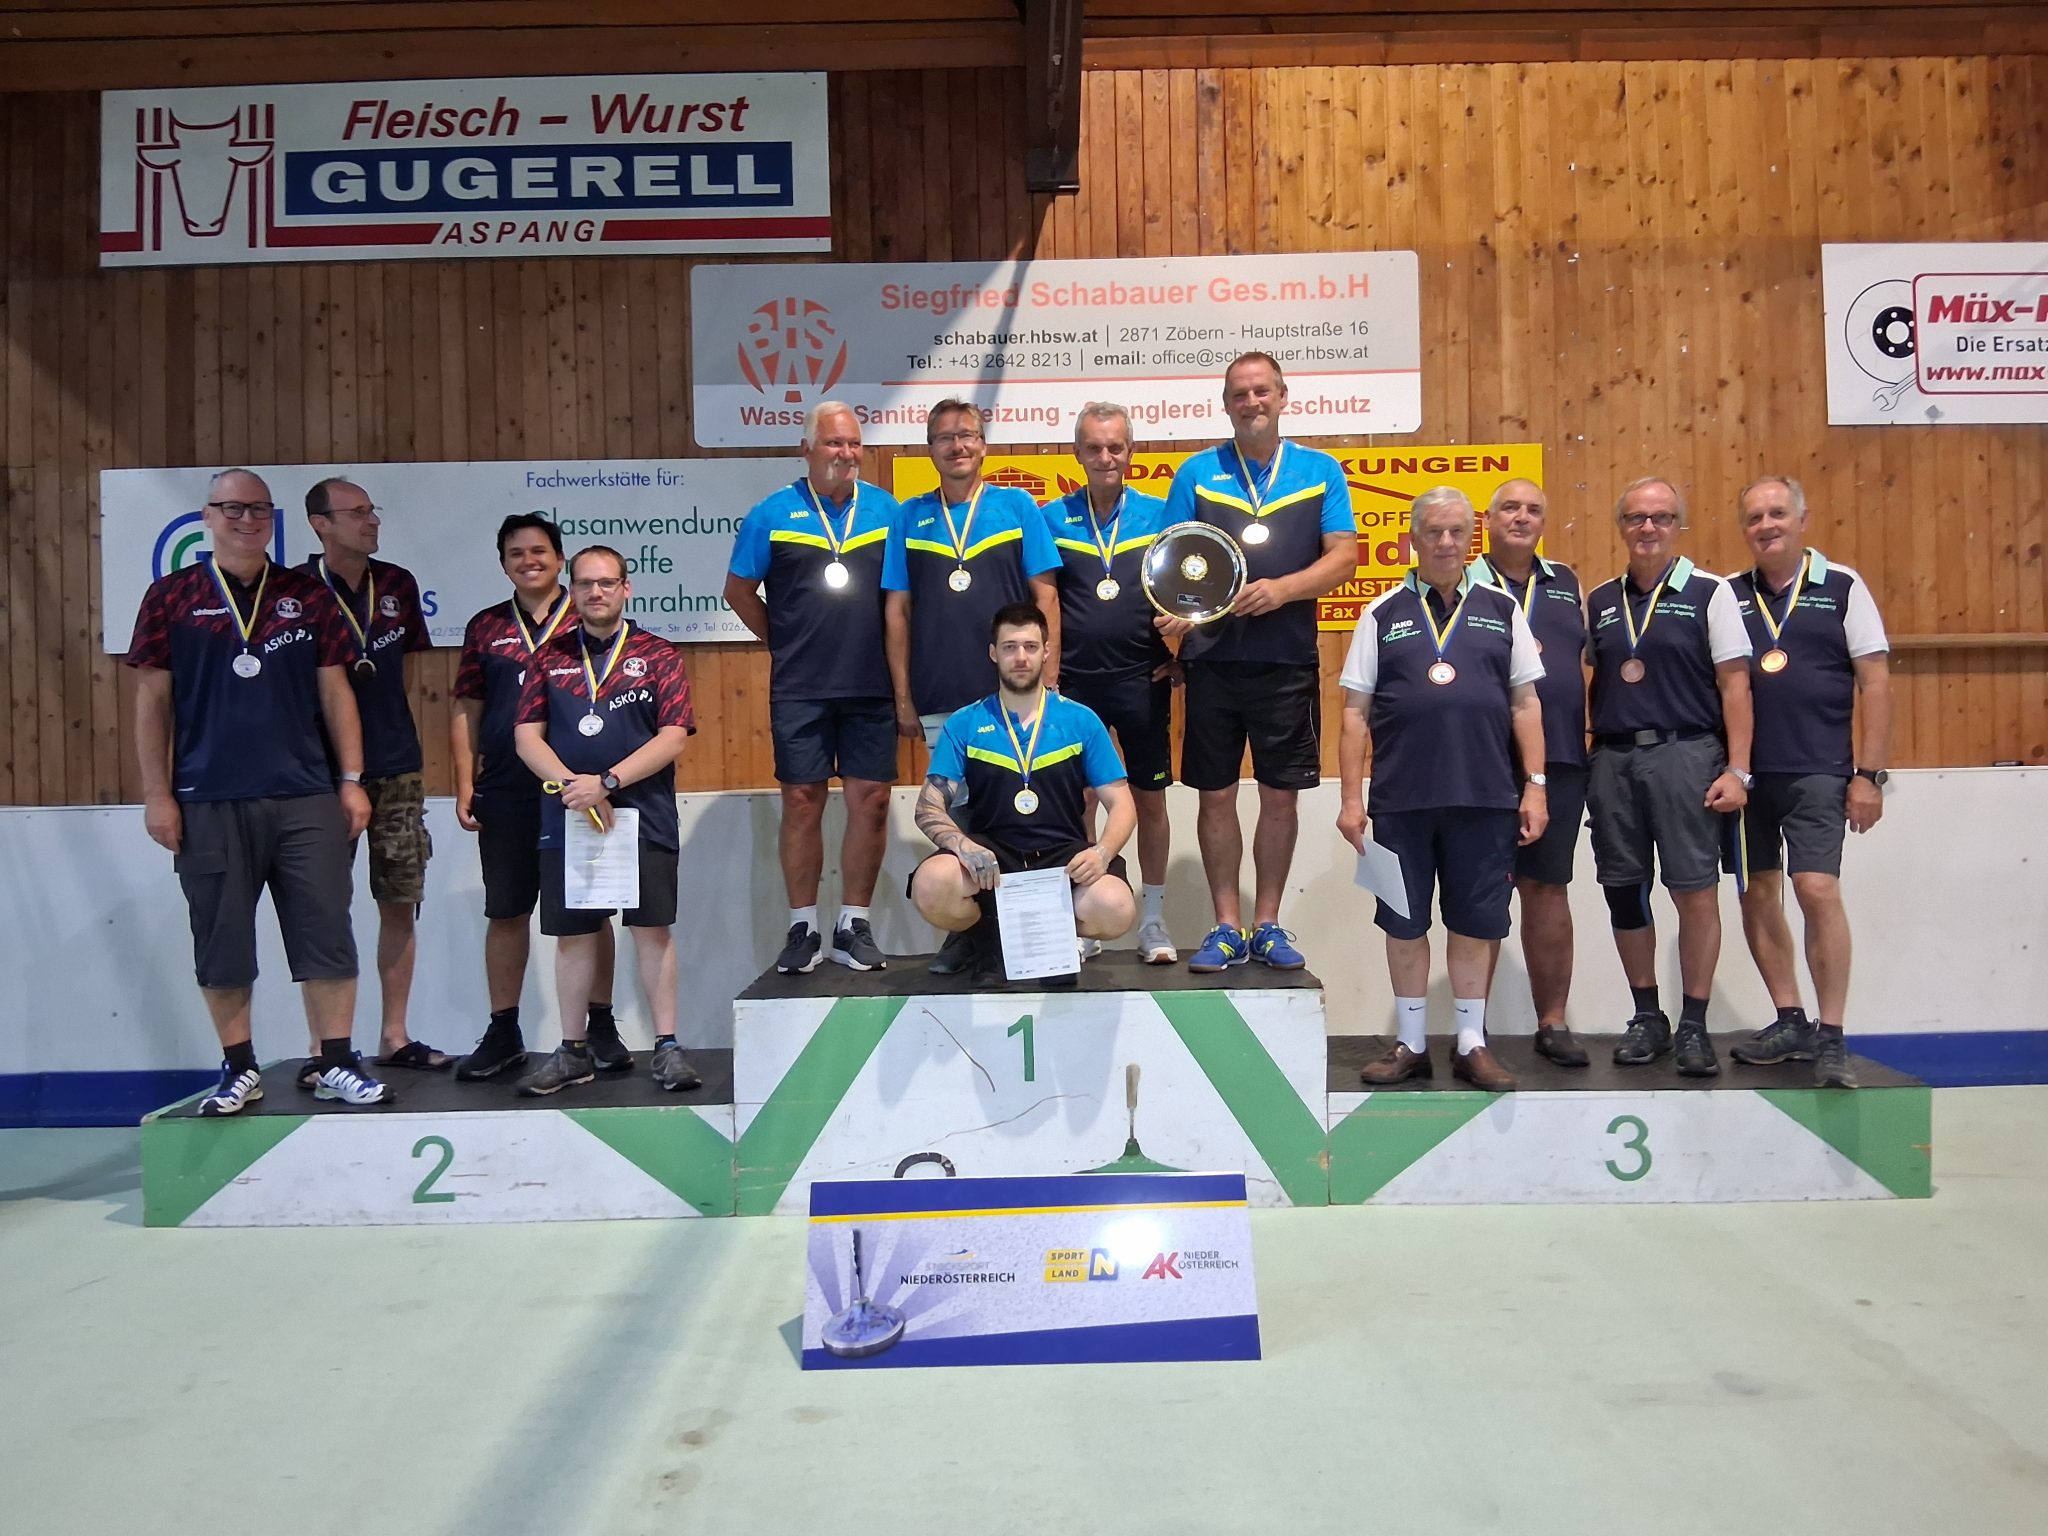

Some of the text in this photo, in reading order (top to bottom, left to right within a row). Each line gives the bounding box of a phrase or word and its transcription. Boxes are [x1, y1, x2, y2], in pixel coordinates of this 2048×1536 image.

[342, 96, 519, 141] Fleisch
[591, 92, 749, 136] Wurst
[310, 154, 782, 205] GUGERELL
[442, 219, 596, 246] ASPANG
[881, 273, 1370, 315] Siegfried Schabauer Ges.m.b.H
[933, 328, 1098, 346] schabauer.hbsw.at
[1119, 327, 1159, 343] 2871
[1166, 325, 1224, 341] Zöbern
[1240, 321, 1343, 340] Hauptstraße
[1348, 320, 1369, 336] 16
[1956, 336, 1986, 352] Die
[907, 355, 943, 370] Tel.:
[949, 354, 980, 369] +43
[985, 352, 1026, 368] 2642
[1031, 352, 1072, 368] 8213
[1093, 350, 1146, 366] email:
[740, 406, 804, 425] Wass
[854, 404, 928, 424] Sanitä
[977, 403, 1060, 426] eizung
[526, 468, 685, 488] Fachwerkstätte für:
[1321, 604, 1354, 618] Fax
[1391, 619, 1414, 630] JAKO
[608, 689, 637, 712] ASKÖ
[1007, 1014, 1036, 1082] 1
[1605, 1114, 1653, 1183] 3
[411, 1135, 456, 1204] 2
[1051, 1251, 1085, 1260] SPORT
[1141, 1252, 1183, 1280] AK
[1183, 1250, 1220, 1260] NIEDER
[900, 1271, 1016, 1285] NIEDERÖSTERREICH
[1051, 1269, 1079, 1278] LAND
